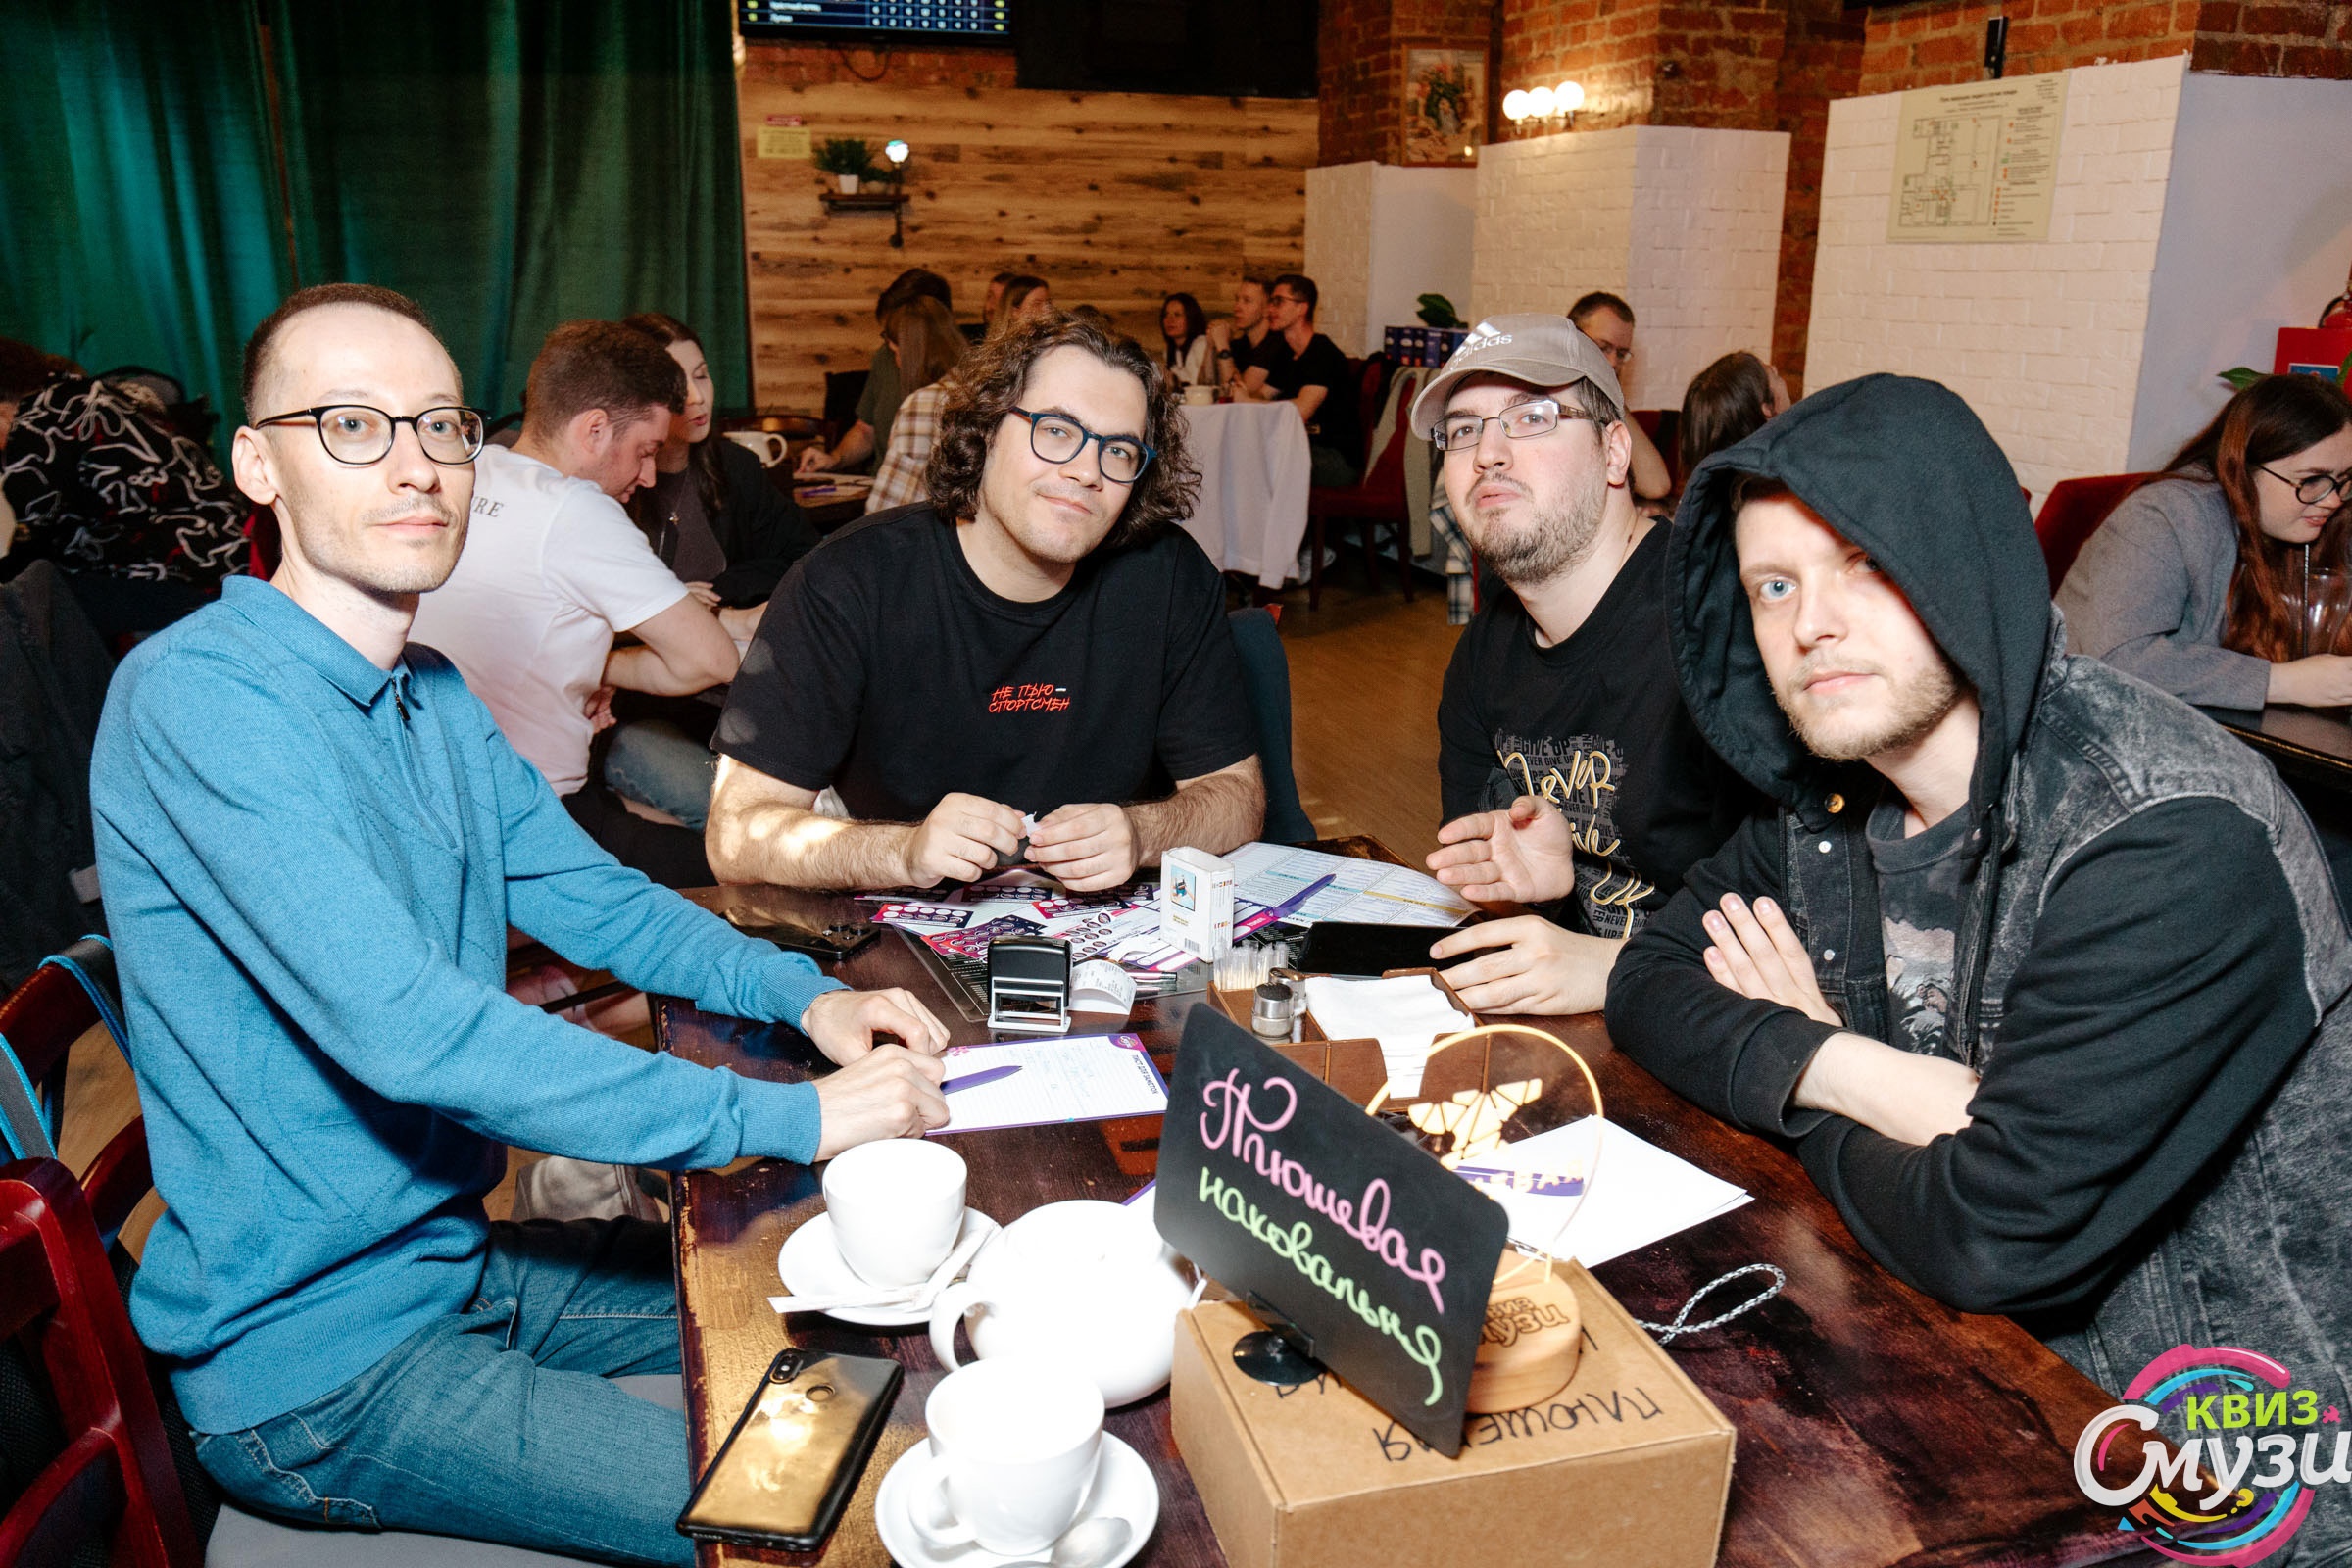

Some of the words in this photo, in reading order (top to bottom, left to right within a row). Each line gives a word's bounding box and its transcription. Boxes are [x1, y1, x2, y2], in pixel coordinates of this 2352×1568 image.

[473, 495, 505, 518] RE
[991, 686, 1014, 702] НЕ
[988, 697, 1071, 713] СПОРТСМЕН
